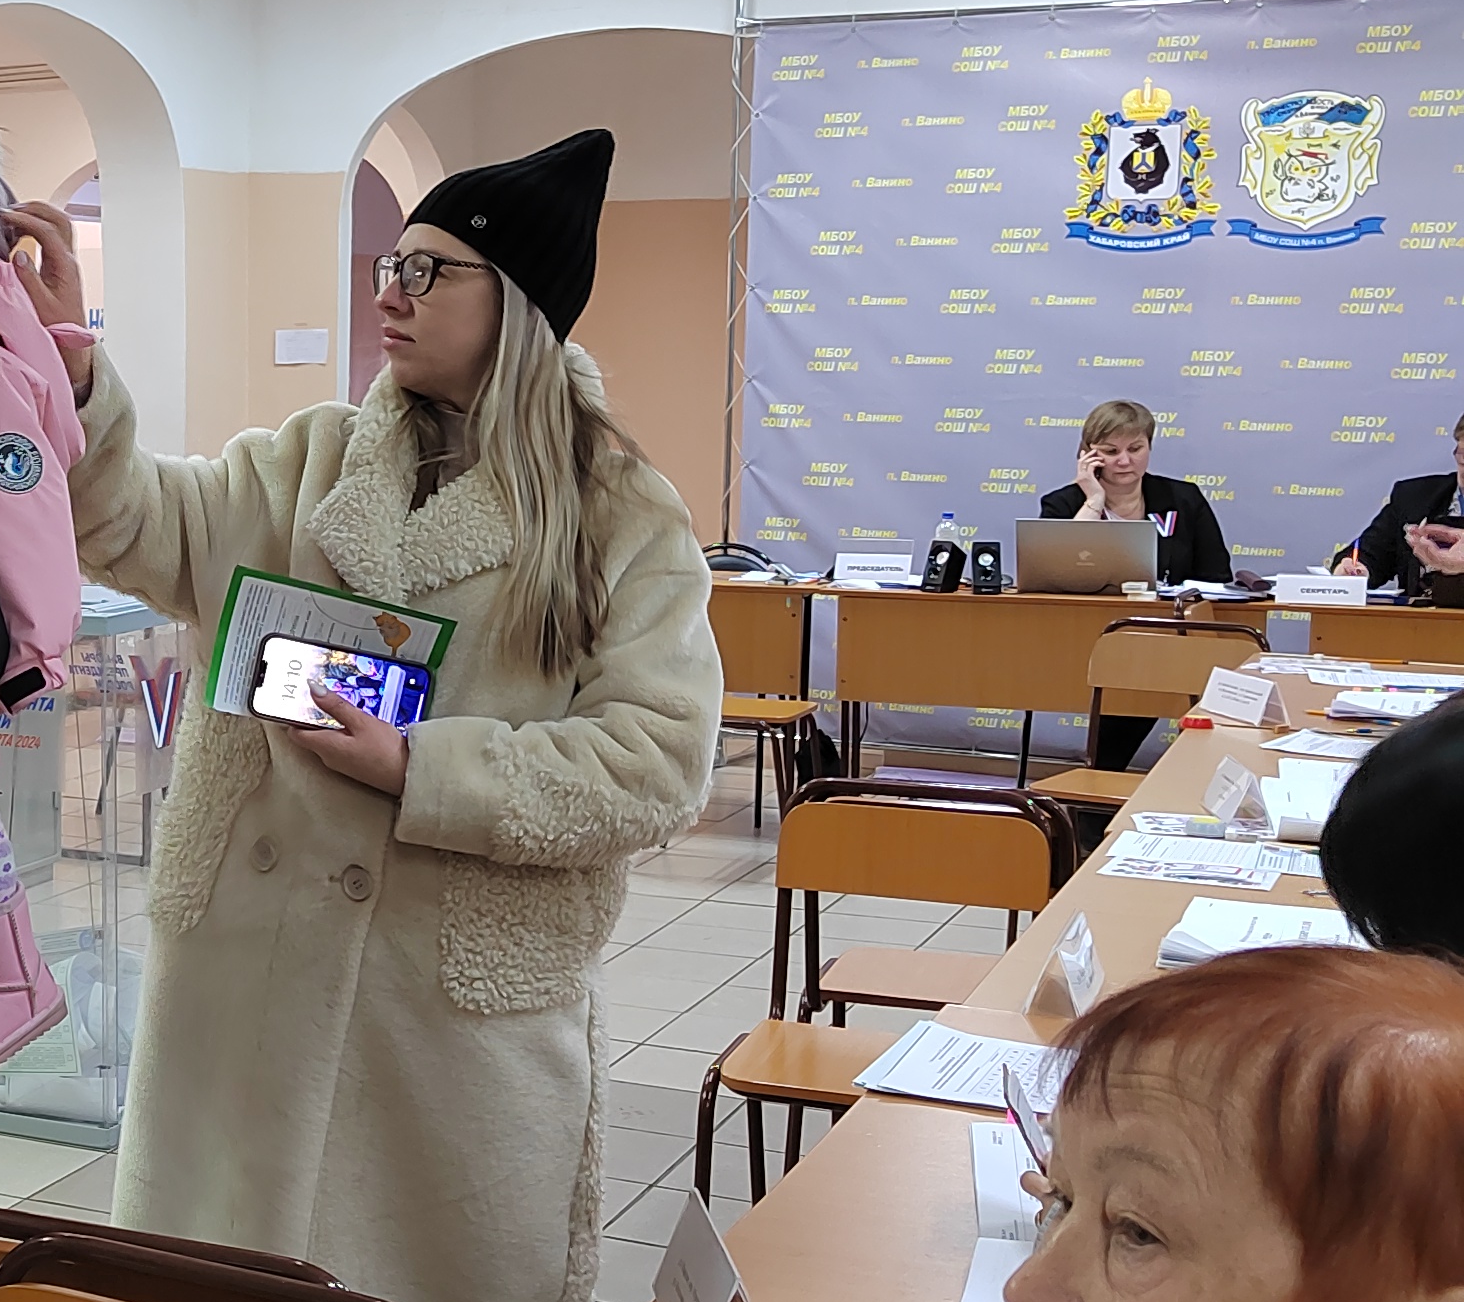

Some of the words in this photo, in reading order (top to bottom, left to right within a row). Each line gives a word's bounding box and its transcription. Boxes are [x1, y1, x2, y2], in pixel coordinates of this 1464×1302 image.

[1367, 24, 1412, 38] МБОУ
[1157, 35, 1199, 48] МБОУ
[1262, 37, 1318, 49] Ванино
[1356, 41, 1392, 54] СОШ
[1393, 40, 1422, 52] №4
[961, 46, 1001, 58] МБОУ
[1059, 47, 1111, 59] Ванино
[1147, 51, 1180, 63] СОШ
[1183, 50, 1208, 61] №4
[780, 54, 818, 67] МБОУ
[870, 57, 919, 68] Ванино
[952, 60, 983, 73] СОШ
[985, 60, 1010, 71] №4
[772, 68, 802, 81] СОШ
[803, 68, 825, 79] №4
[1419, 89, 1464, 102] МБОУ
[1007, 105, 1048, 117] МБОУ
[1408, 104, 1441, 118] СОШ
[823, 112, 861, 124] МБОУ
[914, 115, 965, 127] Ванино
[998, 119, 1030, 132] СОШ
[1031, 119, 1056, 131] №4
[815, 126, 845, 138] СОШ
[846, 126, 869, 137] №4
[776, 173, 812, 185] МБОУ
[954, 168, 995, 179] МБОУ
[864, 176, 913, 188] Ванино
[945, 182, 977, 194] СОШ
[978, 182, 1003, 193] №4
[768, 186, 797, 198] СОШ
[798, 186, 820, 197] №4
[1000, 228, 1041, 240] МБОУ
[1410, 222, 1457, 235] МБОУ
[819, 231, 856, 242] МБОУ
[909, 235, 958, 246] Ванино
[1089, 234, 1161, 248] ХАБАРОВСКИЙ
[1163, 231, 1191, 245] КРАЙ
[1399, 236, 1434, 249] СОШ
[810, 243, 840, 256] СОШ
[841, 243, 864, 255] №4
[991, 241, 1023, 254] СОШ
[1024, 241, 1049, 253] №4
[949, 289, 988, 300] МБОУ
[1043, 294, 1097, 306] Ванино
[1142, 288, 1185, 300] МБОУ
[1245, 293, 1302, 305] Ванино
[1349, 287, 1395, 301] МБОУ
[940, 301, 971, 314] СОШ
[972, 301, 996, 314] №4
[1132, 301, 1166, 314] СОШ
[1167, 302, 1193, 314] №4
[1339, 301, 1375, 315] СОШ
[1378, 301, 1404, 314] №4
[994, 349, 1035, 361] МБОУ
[1092, 355, 1144, 367] Ванино
[1191, 350, 1234, 362] МБОУ
[1401, 352, 1448, 365] МБОУ
[985, 362, 1017, 374] СОШ
[1018, 363, 1043, 374] №4
[1296, 357, 1352, 370] Ванино
[1180, 363, 1214, 377] СОШ
[1215, 363, 1242, 377] №4
[1390, 367, 1427, 379] СОШ
[1429, 367, 1456, 379] №4
[846, 565, 904, 573] ПРЕДСЕДАТЕЛЬ
[1300, 587, 1349, 595] СЕКРЕТАРЬ
[15, 735, 41, 749] 2024
